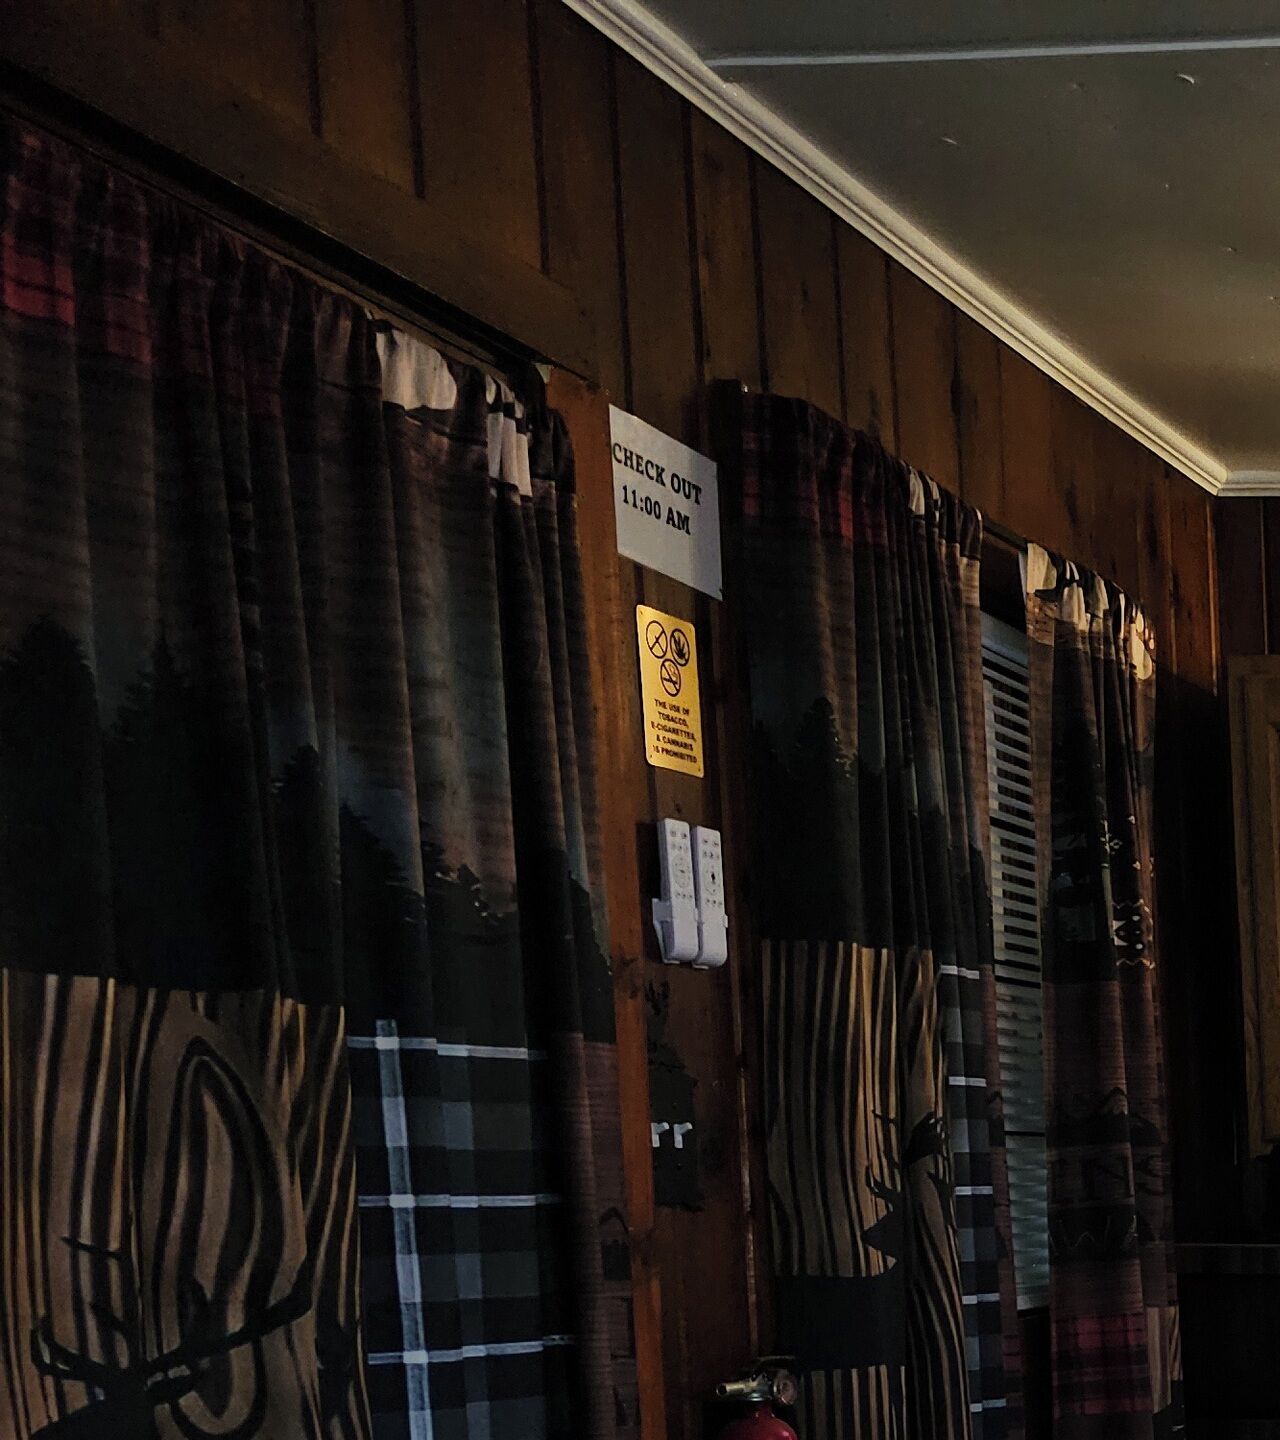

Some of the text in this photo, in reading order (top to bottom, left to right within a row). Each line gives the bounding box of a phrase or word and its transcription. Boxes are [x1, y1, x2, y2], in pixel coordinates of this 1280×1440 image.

[613, 442, 702, 505] CHECK OUT
[622, 484, 691, 536] 11:00 AM
